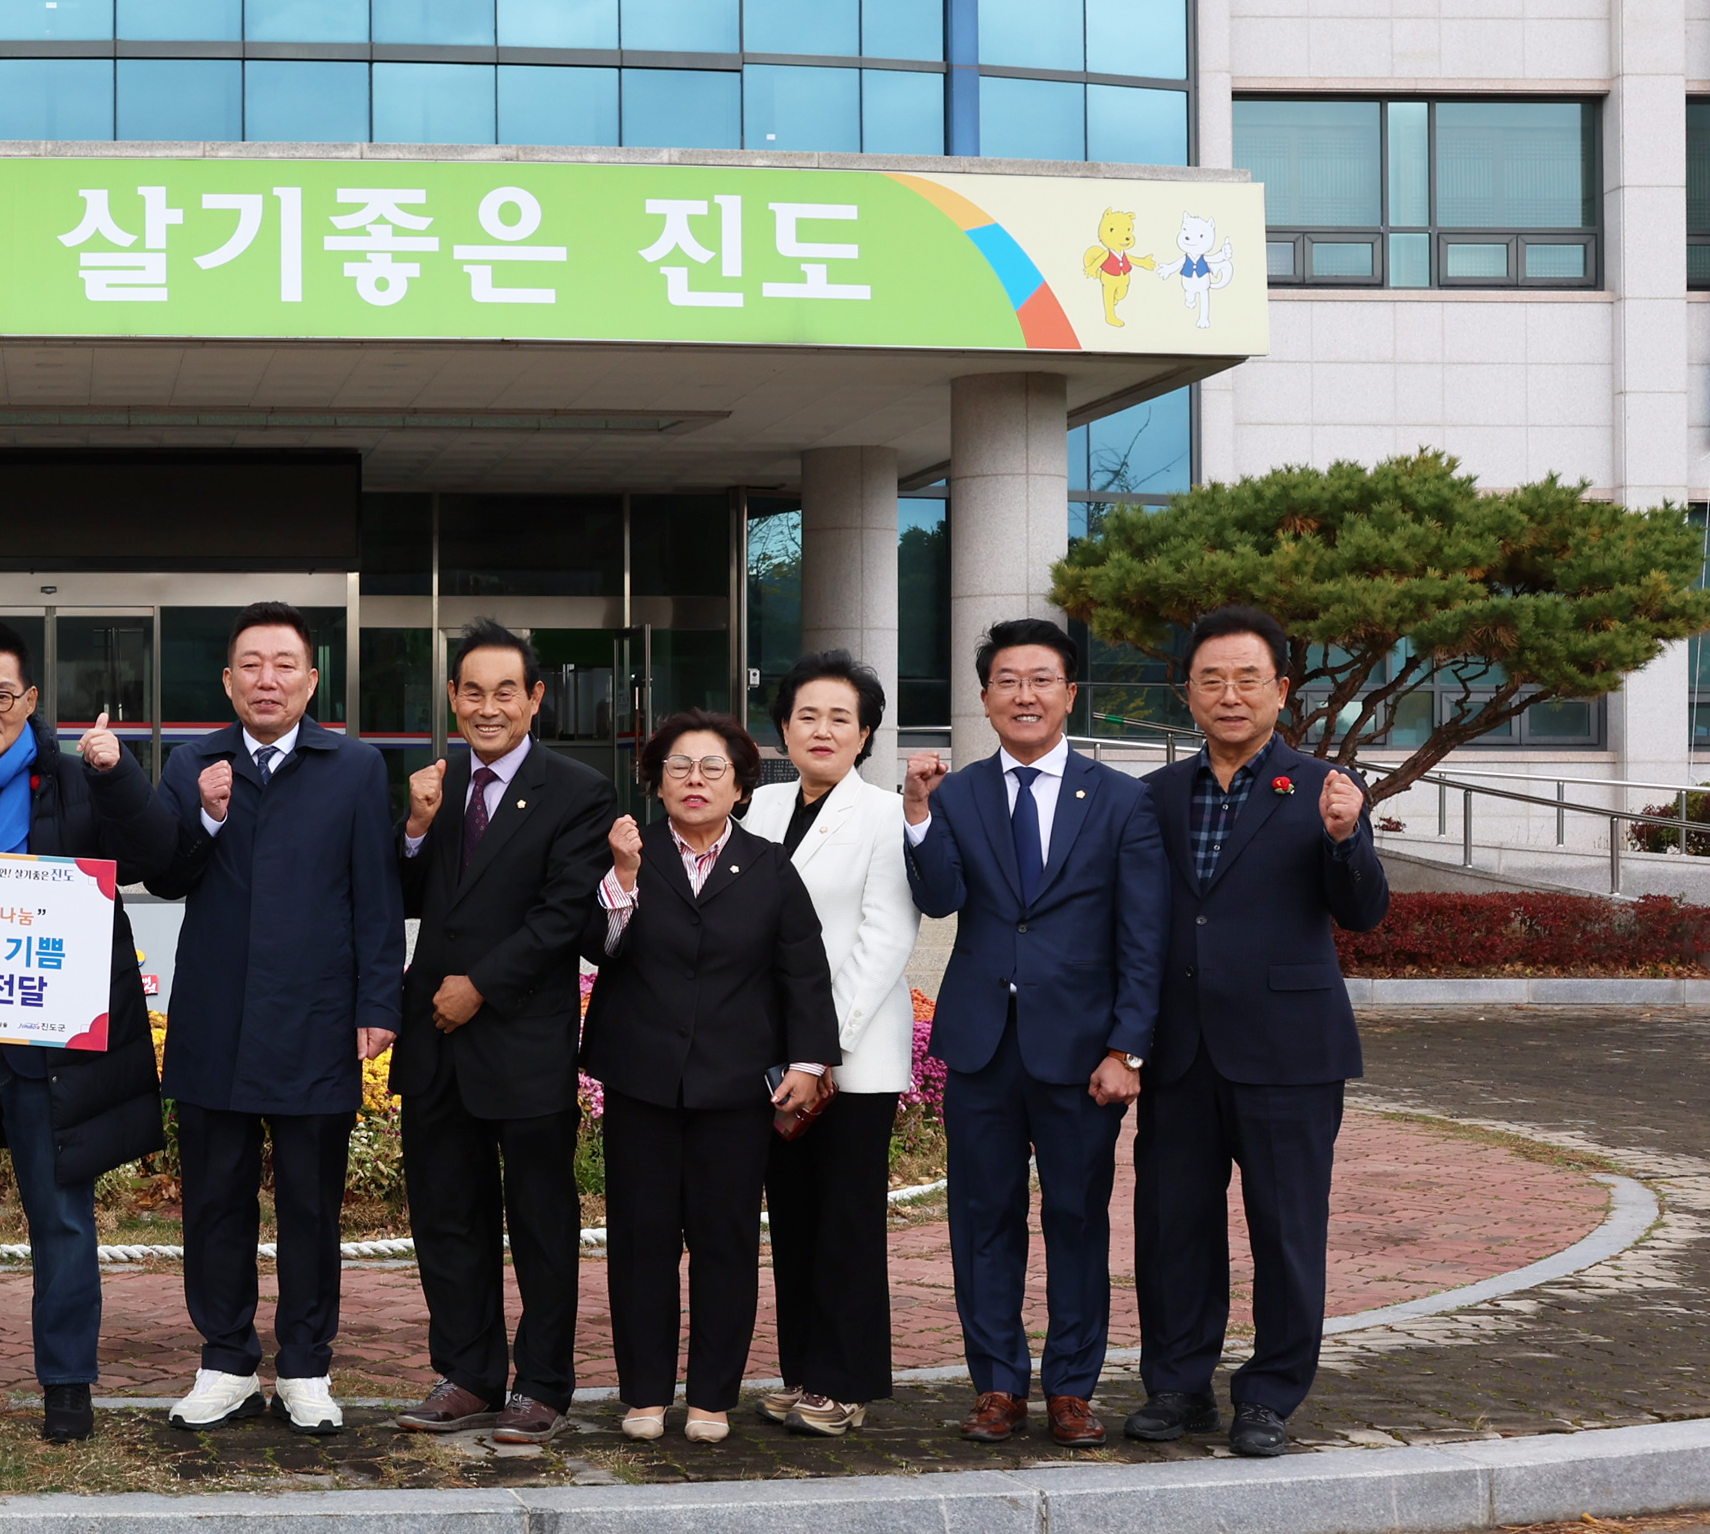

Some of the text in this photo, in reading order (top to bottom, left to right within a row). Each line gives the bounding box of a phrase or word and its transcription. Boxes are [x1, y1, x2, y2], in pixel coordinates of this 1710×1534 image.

[58, 186, 567, 306] 살기좋은
[638, 195, 871, 307] 진도
[14, 868, 49, 881] 살기좋은
[50, 868, 75, 882] 진도
[0, 908, 46, 925] 나눔”
[5, 936, 65, 969] 기쁨
[41, 1023, 65, 1032] 진도군
